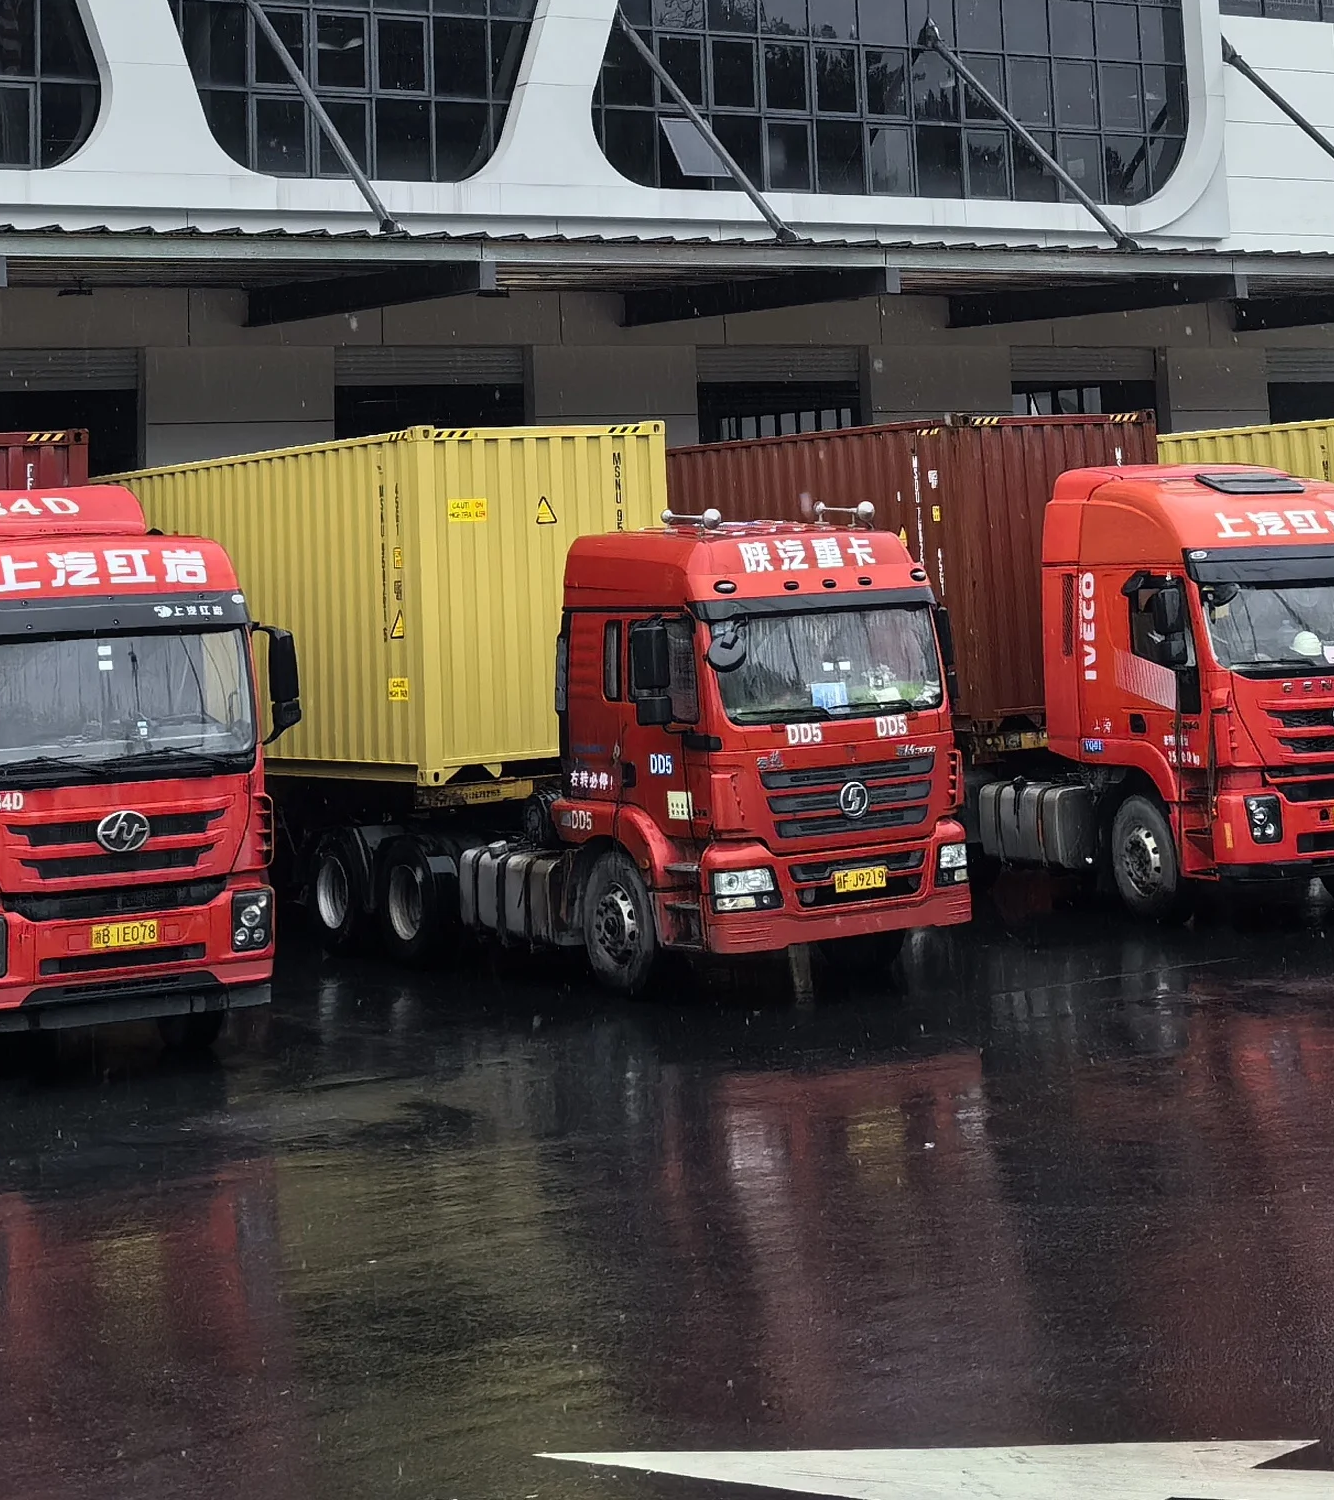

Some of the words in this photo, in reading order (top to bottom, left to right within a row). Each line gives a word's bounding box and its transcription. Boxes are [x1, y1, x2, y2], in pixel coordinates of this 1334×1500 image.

[737, 536, 876, 574] 陕汽重卡
[1082, 572, 1097, 680] IVECO
[785, 723, 823, 745] DD5
[875, 715, 908, 737] DD5
[650, 753, 672, 775] DD5
[571, 810, 592, 830] DD5
